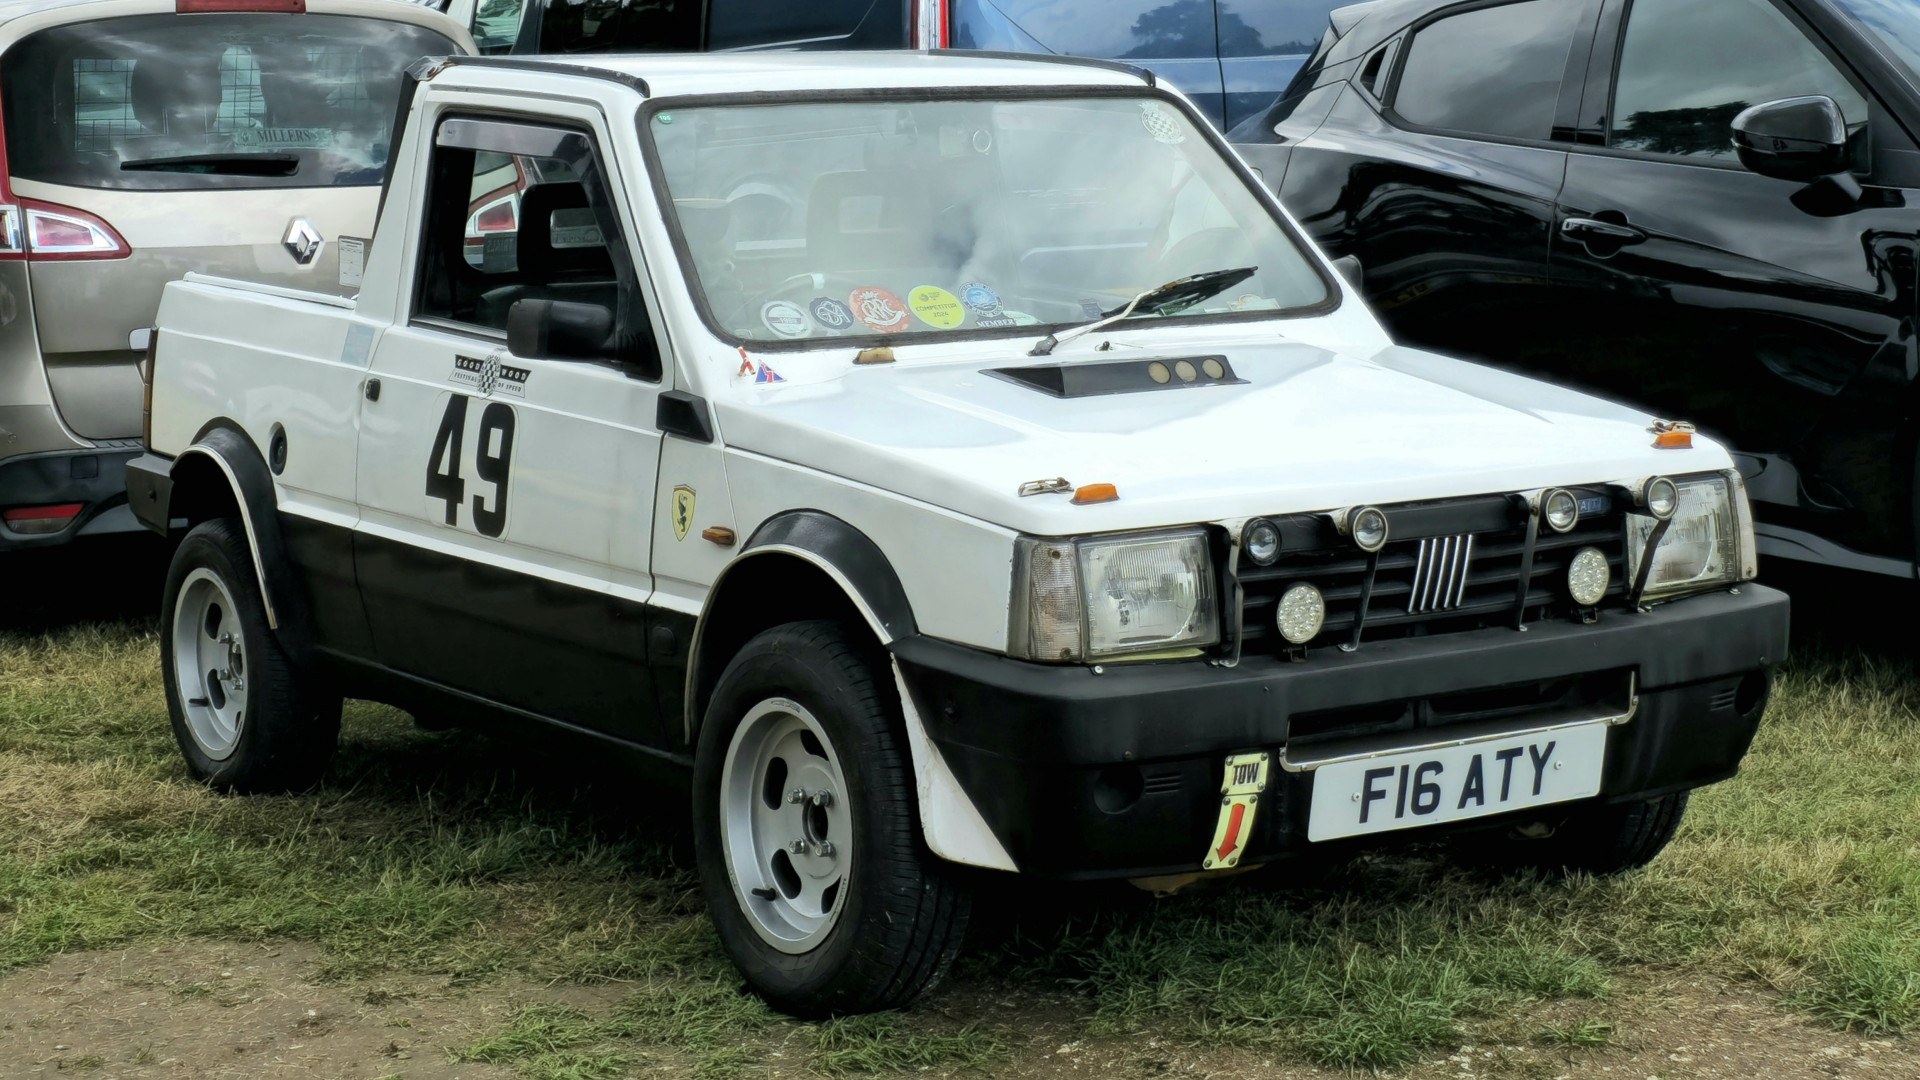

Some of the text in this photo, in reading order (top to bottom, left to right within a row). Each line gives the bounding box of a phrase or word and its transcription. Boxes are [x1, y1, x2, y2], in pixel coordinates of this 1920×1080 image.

[257, 129, 311, 143] MILLERS
[915, 303, 958, 312] COMPETITOR
[975, 318, 1016, 328] MEMBER
[456, 358, 528, 381] GOOD WOOD
[454, 371, 478, 383] FESTIVAL
[505, 383, 522, 393] SPEED
[425, 393, 517, 538] 49
[1232, 762, 1260, 786] TOW
[1359, 740, 1557, 824] F16 ATY
